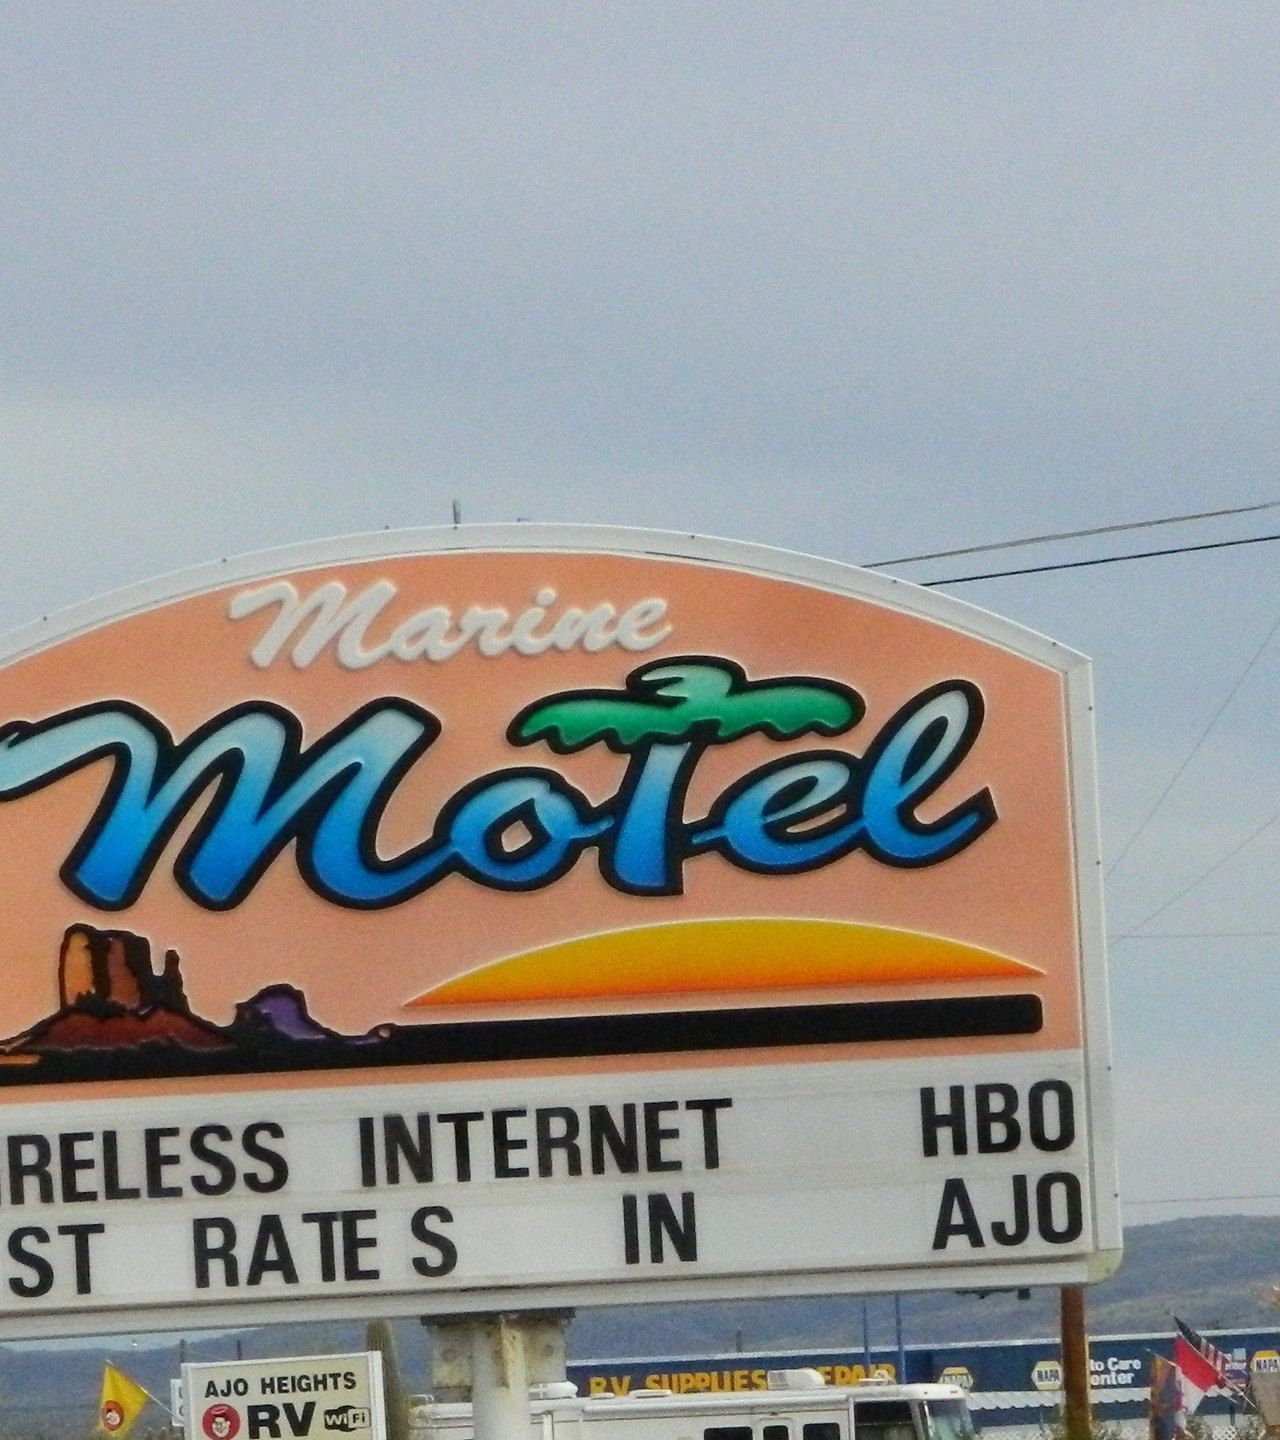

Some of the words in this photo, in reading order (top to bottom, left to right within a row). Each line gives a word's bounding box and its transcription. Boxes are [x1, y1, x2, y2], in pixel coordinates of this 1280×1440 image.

[228, 579, 673, 671] Marine
[358, 1097, 733, 1188] INTERNET
[919, 1079, 1075, 1158] HBO
[192, 1205, 458, 1289] RATES
[622, 1191, 698, 1265] IN
[932, 1171, 1083, 1251] AJO
[1091, 1372, 1135, 1386] enter
[1107, 1357, 1142, 1371] Care
[204, 1378, 249, 1398] AJO
[261, 1371, 357, 1395] HEIGHTS
[589, 1374, 632, 1397] RV
[644, 1370, 768, 1394] SUPPLIES
[247, 1402, 317, 1440] RV
